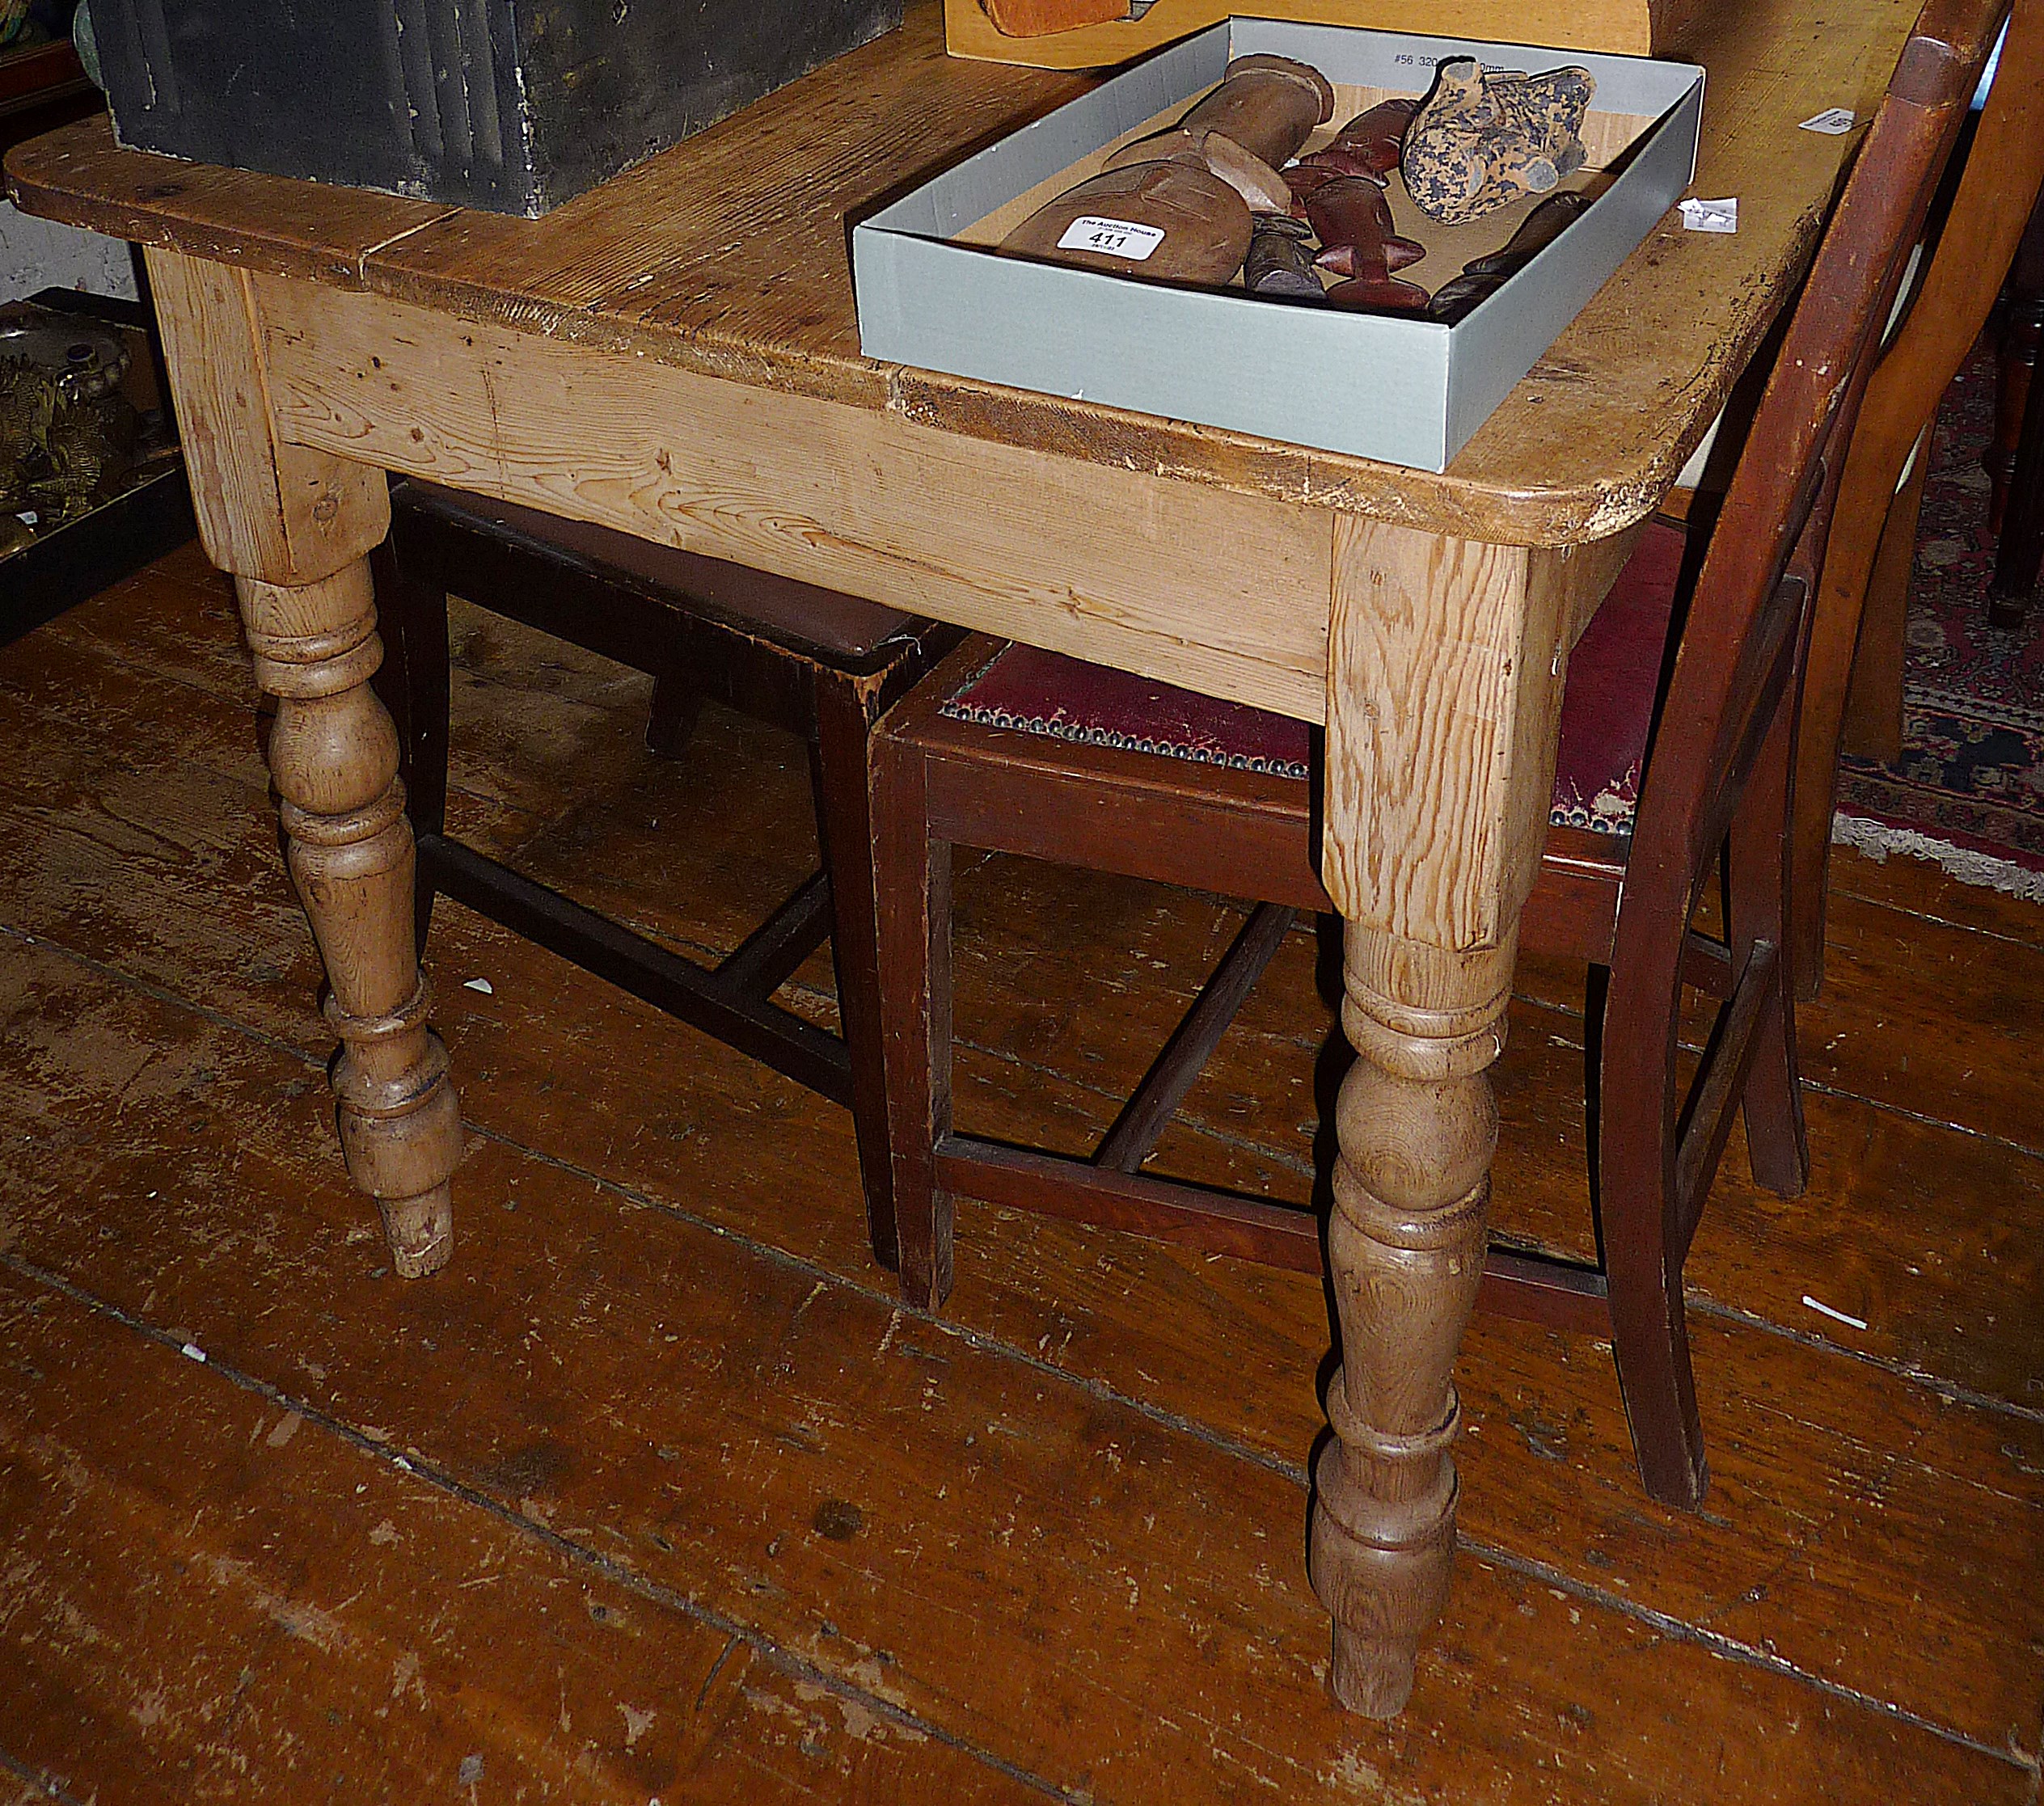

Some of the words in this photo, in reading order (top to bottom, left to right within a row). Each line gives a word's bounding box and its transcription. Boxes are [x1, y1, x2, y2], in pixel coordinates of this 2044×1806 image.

[1395, 54, 1413, 65] #56
[1097, 222, 1129, 230] Auction
[1130, 227, 1156, 237] House
[1089, 232, 1127, 247] 411
